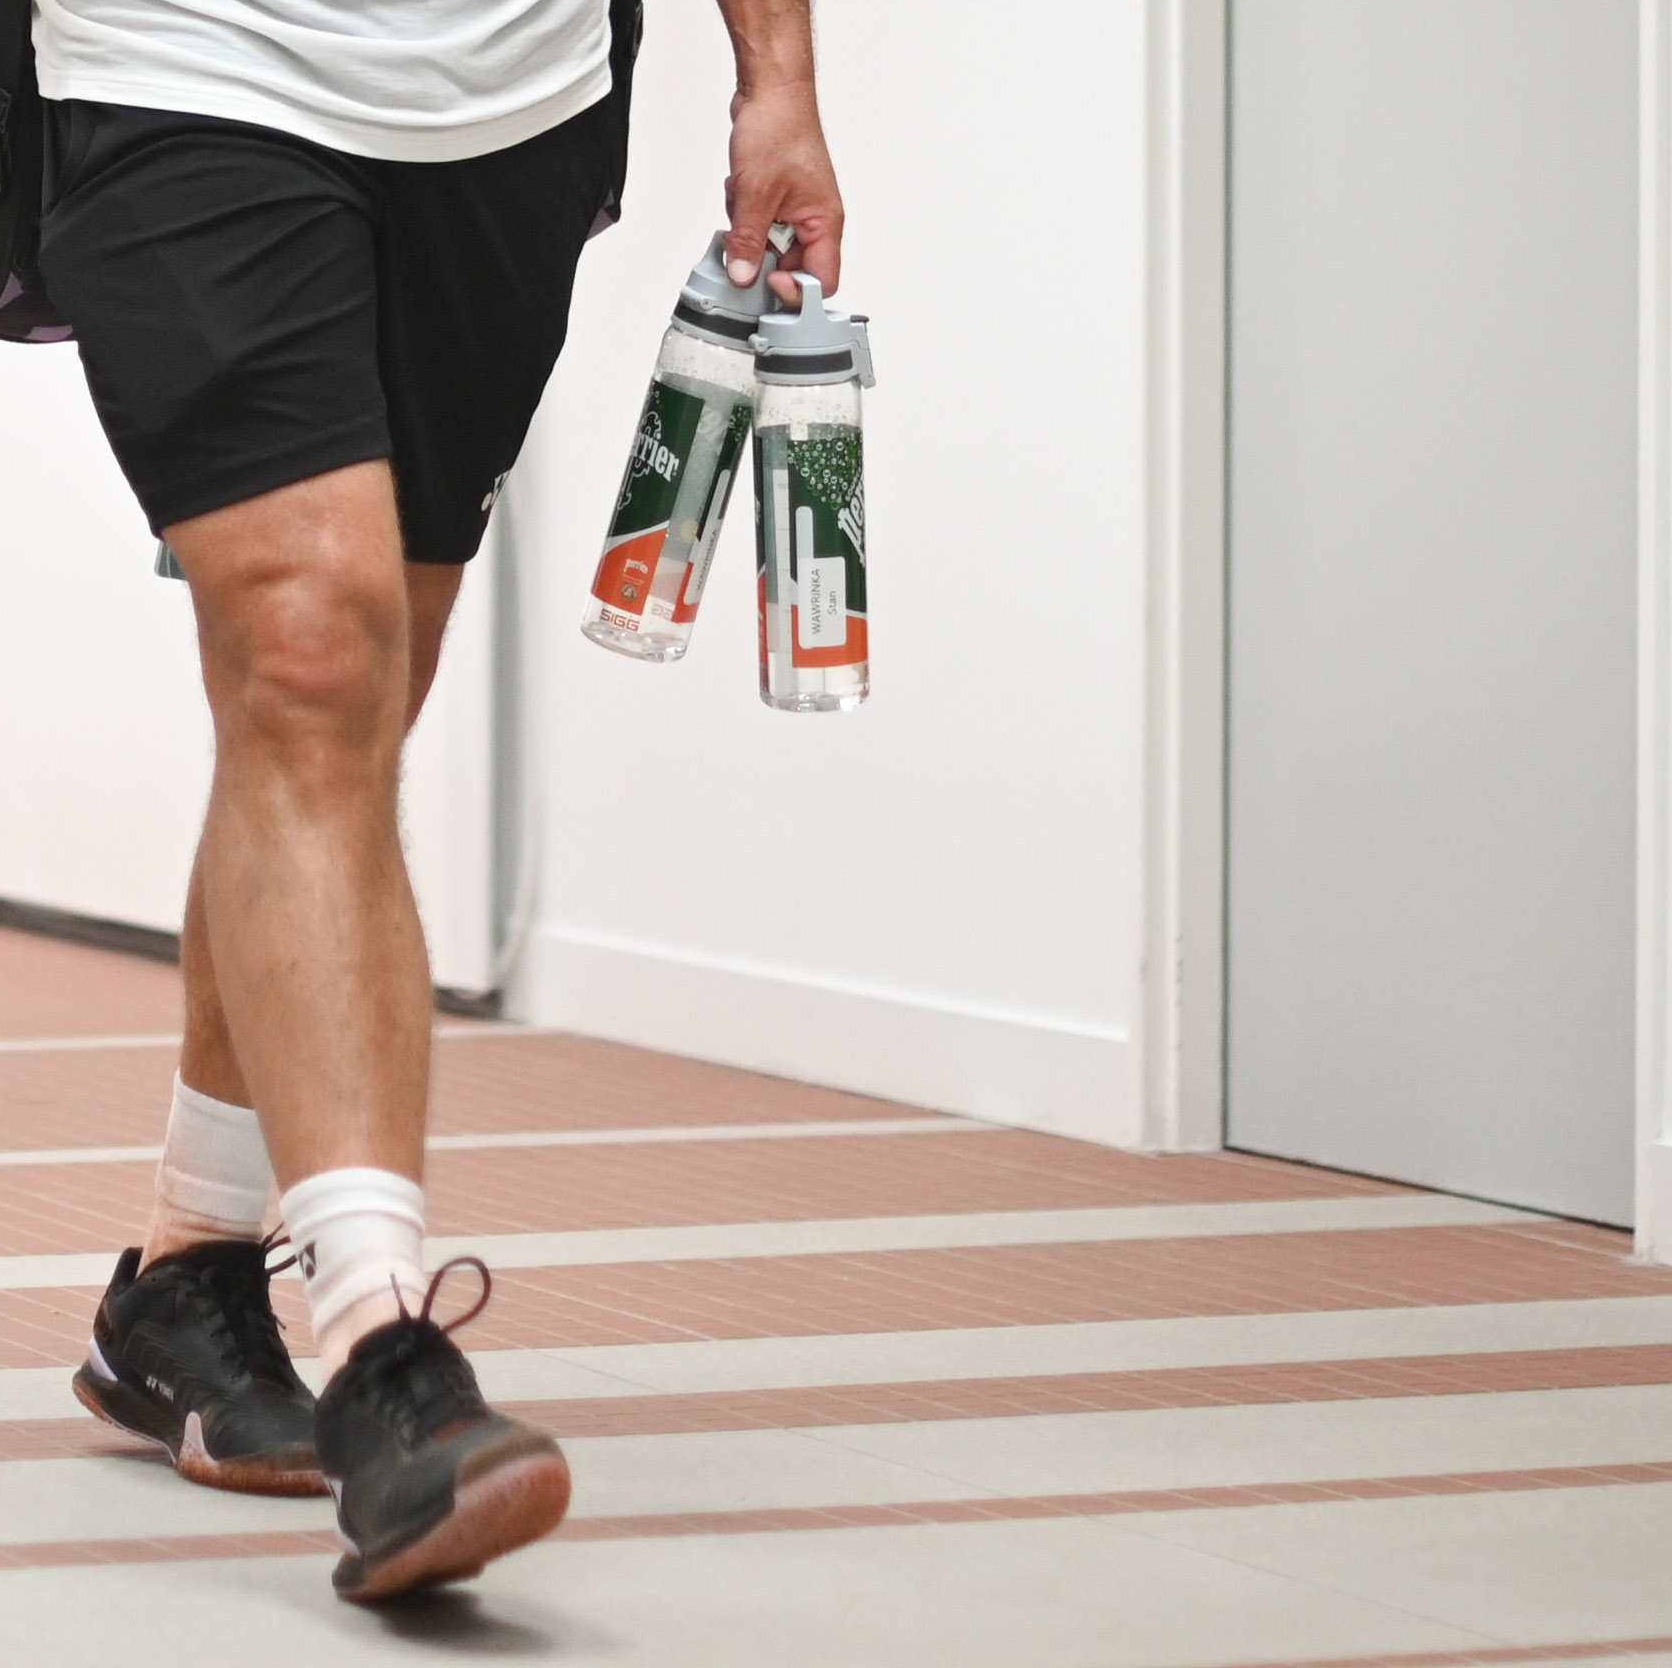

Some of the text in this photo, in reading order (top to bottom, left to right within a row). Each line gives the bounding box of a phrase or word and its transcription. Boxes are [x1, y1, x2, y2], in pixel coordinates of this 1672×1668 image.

[631, 432, 679, 482] rrier
[600, 608, 640, 632] SIGG
[810, 568, 821, 636] WAWRINKA
[827, 590, 837, 615] Stan
